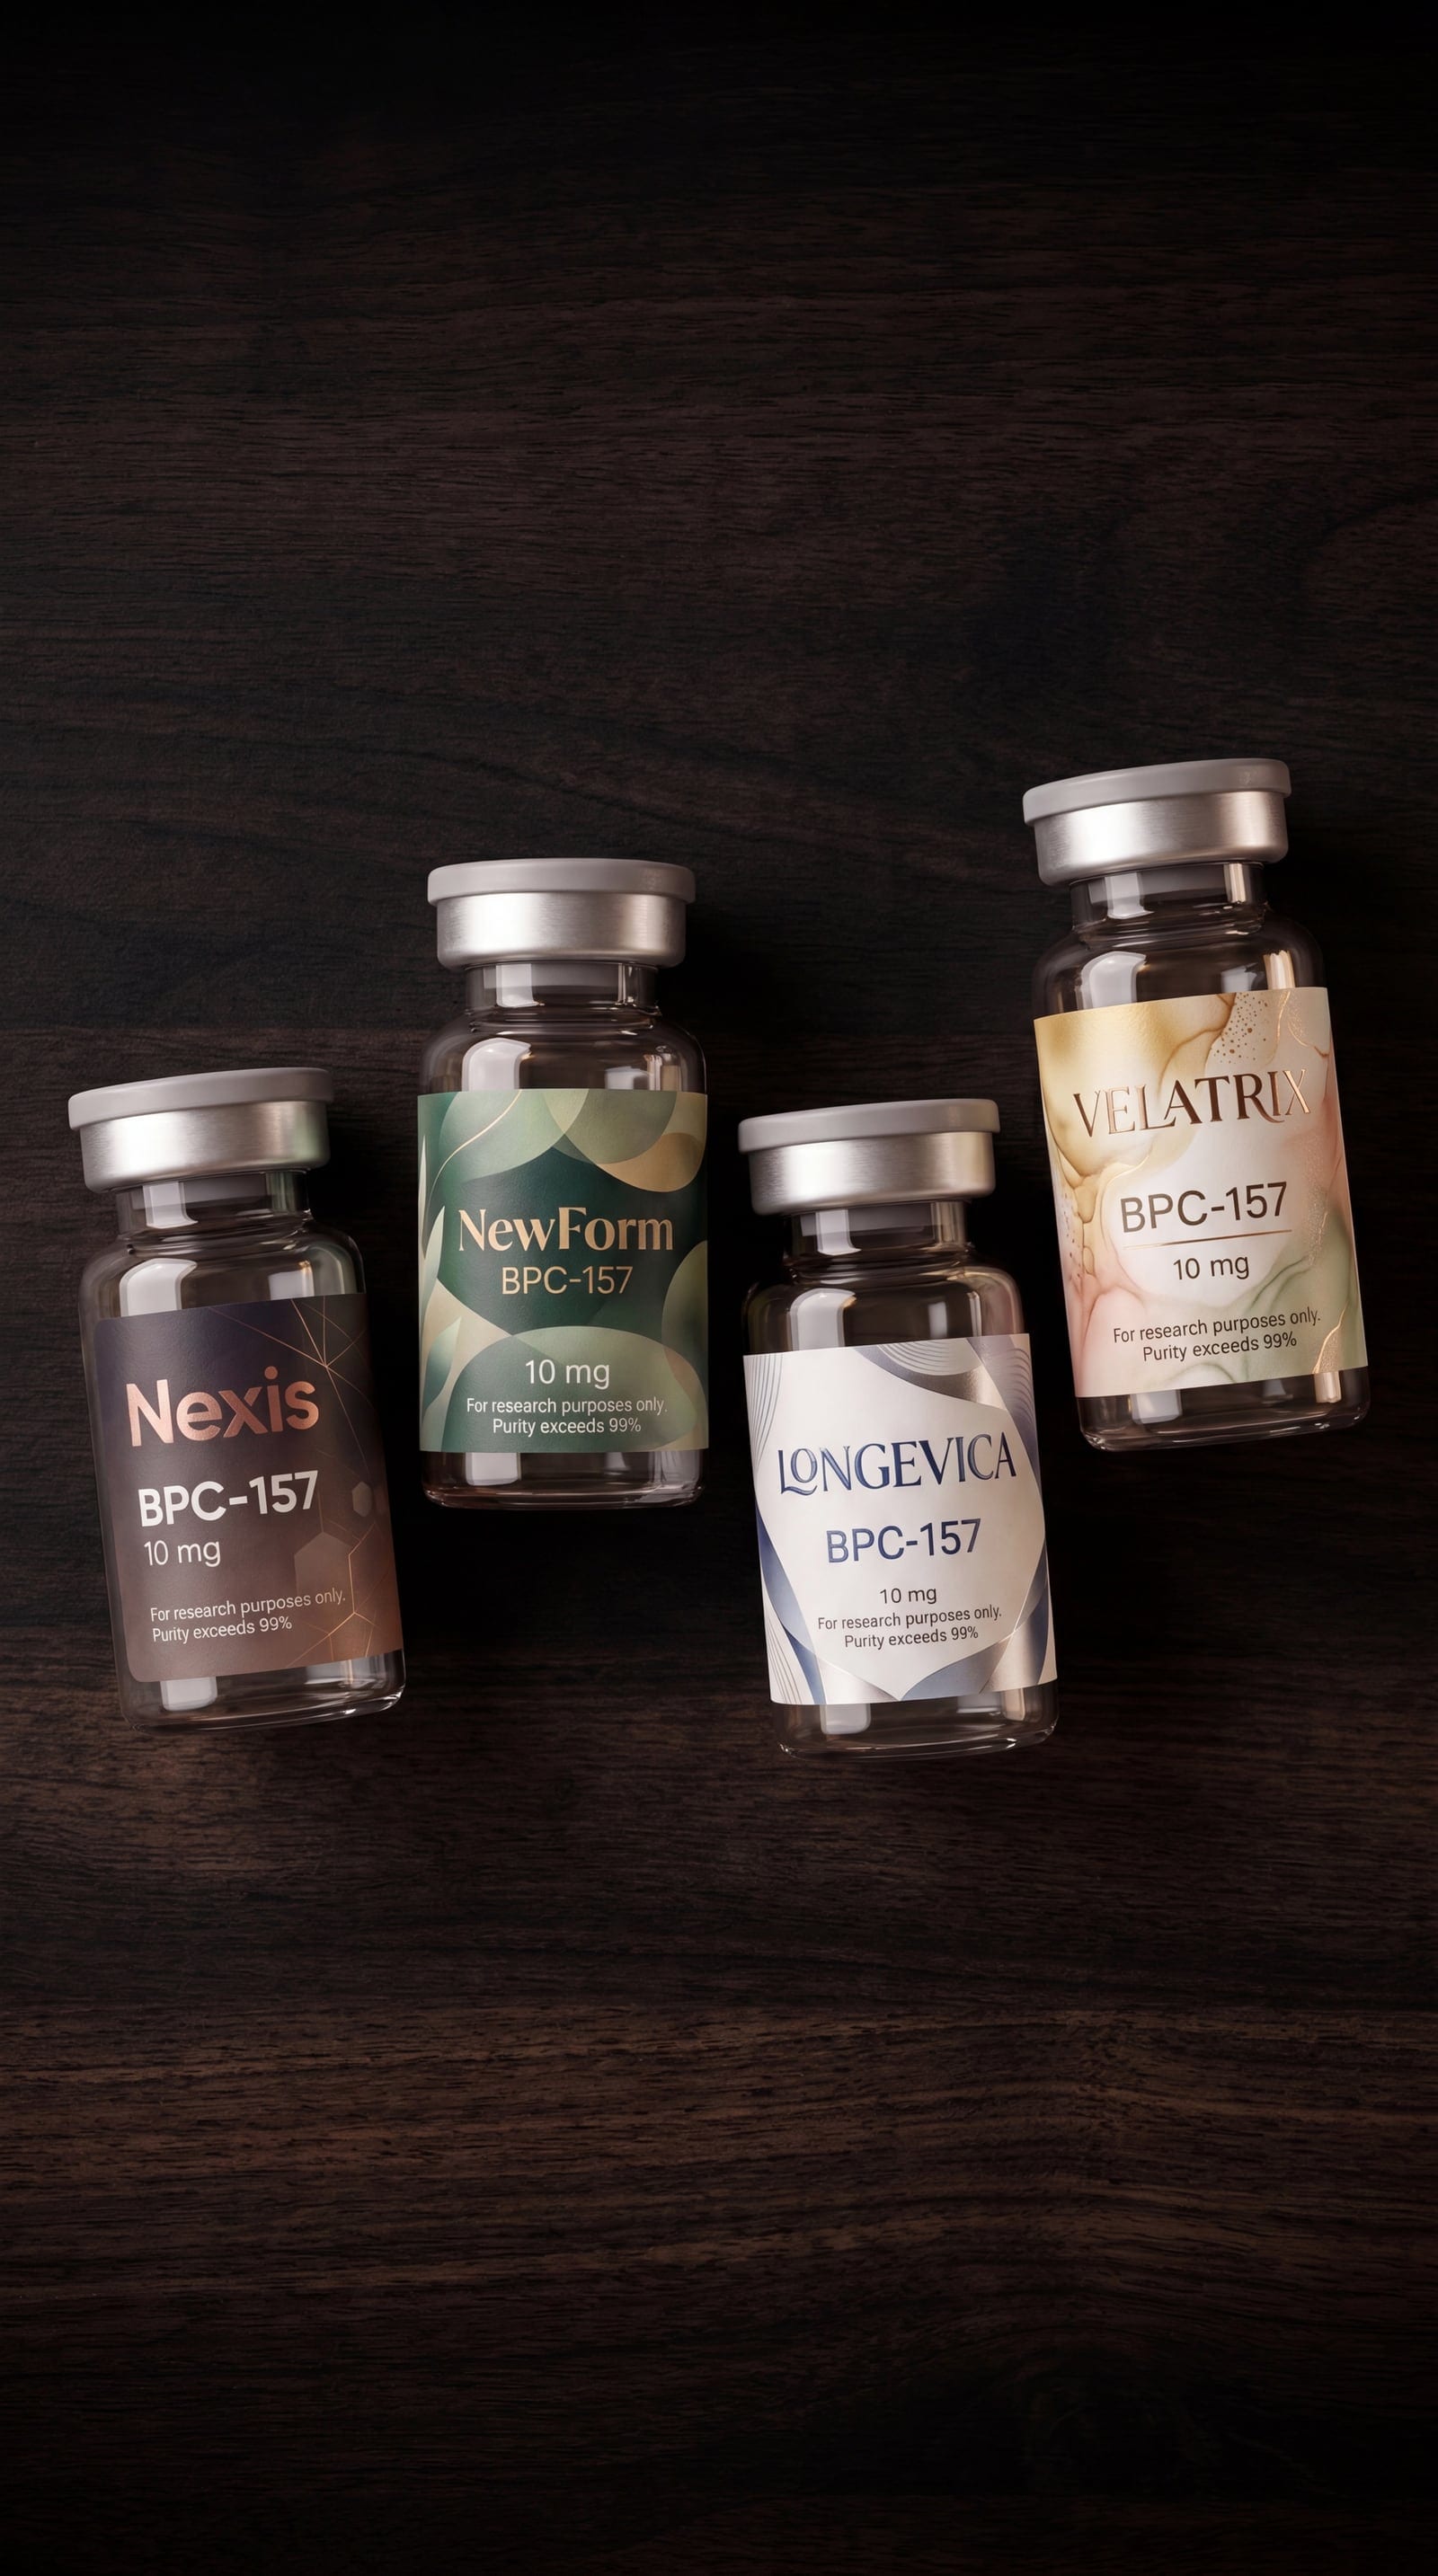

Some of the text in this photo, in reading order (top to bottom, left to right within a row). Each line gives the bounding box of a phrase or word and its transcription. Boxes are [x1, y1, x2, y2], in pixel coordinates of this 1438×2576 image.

[1073, 1068, 1311, 1138] VELATRIX
[1120, 1182, 1287, 1233] BPC-157
[458, 1207, 673, 1252] NewForm
[502, 1266, 633, 1294] BPC-157
[1173, 1256, 1249, 1279] 10 mg
[1114, 1306, 1321, 1343] For research purposes only.
[1142, 1332, 1297, 1361] Purity exceeds 99%
[525, 1359, 610, 1389] 10 mg
[126, 1366, 319, 1447] Nexis
[466, 1396, 668, 1415] For research purposes only.
[493, 1418, 642, 1437] Purity exceeds 99%
[777, 1431, 1016, 1496] LONGEVICA
[138, 1470, 318, 1527] BPC-157
[144, 1539, 221, 1567] 10 mg
[826, 1518, 981, 1563] BPC-157
[150, 1588, 346, 1622] For research purposes only.
[880, 1588, 937, 1605] 10 mg
[153, 1616, 292, 1644] Purity exceeds 99%
[818, 1605, 1002, 1630] For research purposes only.
[845, 1625, 979, 1651] Purity exceeds 99%
